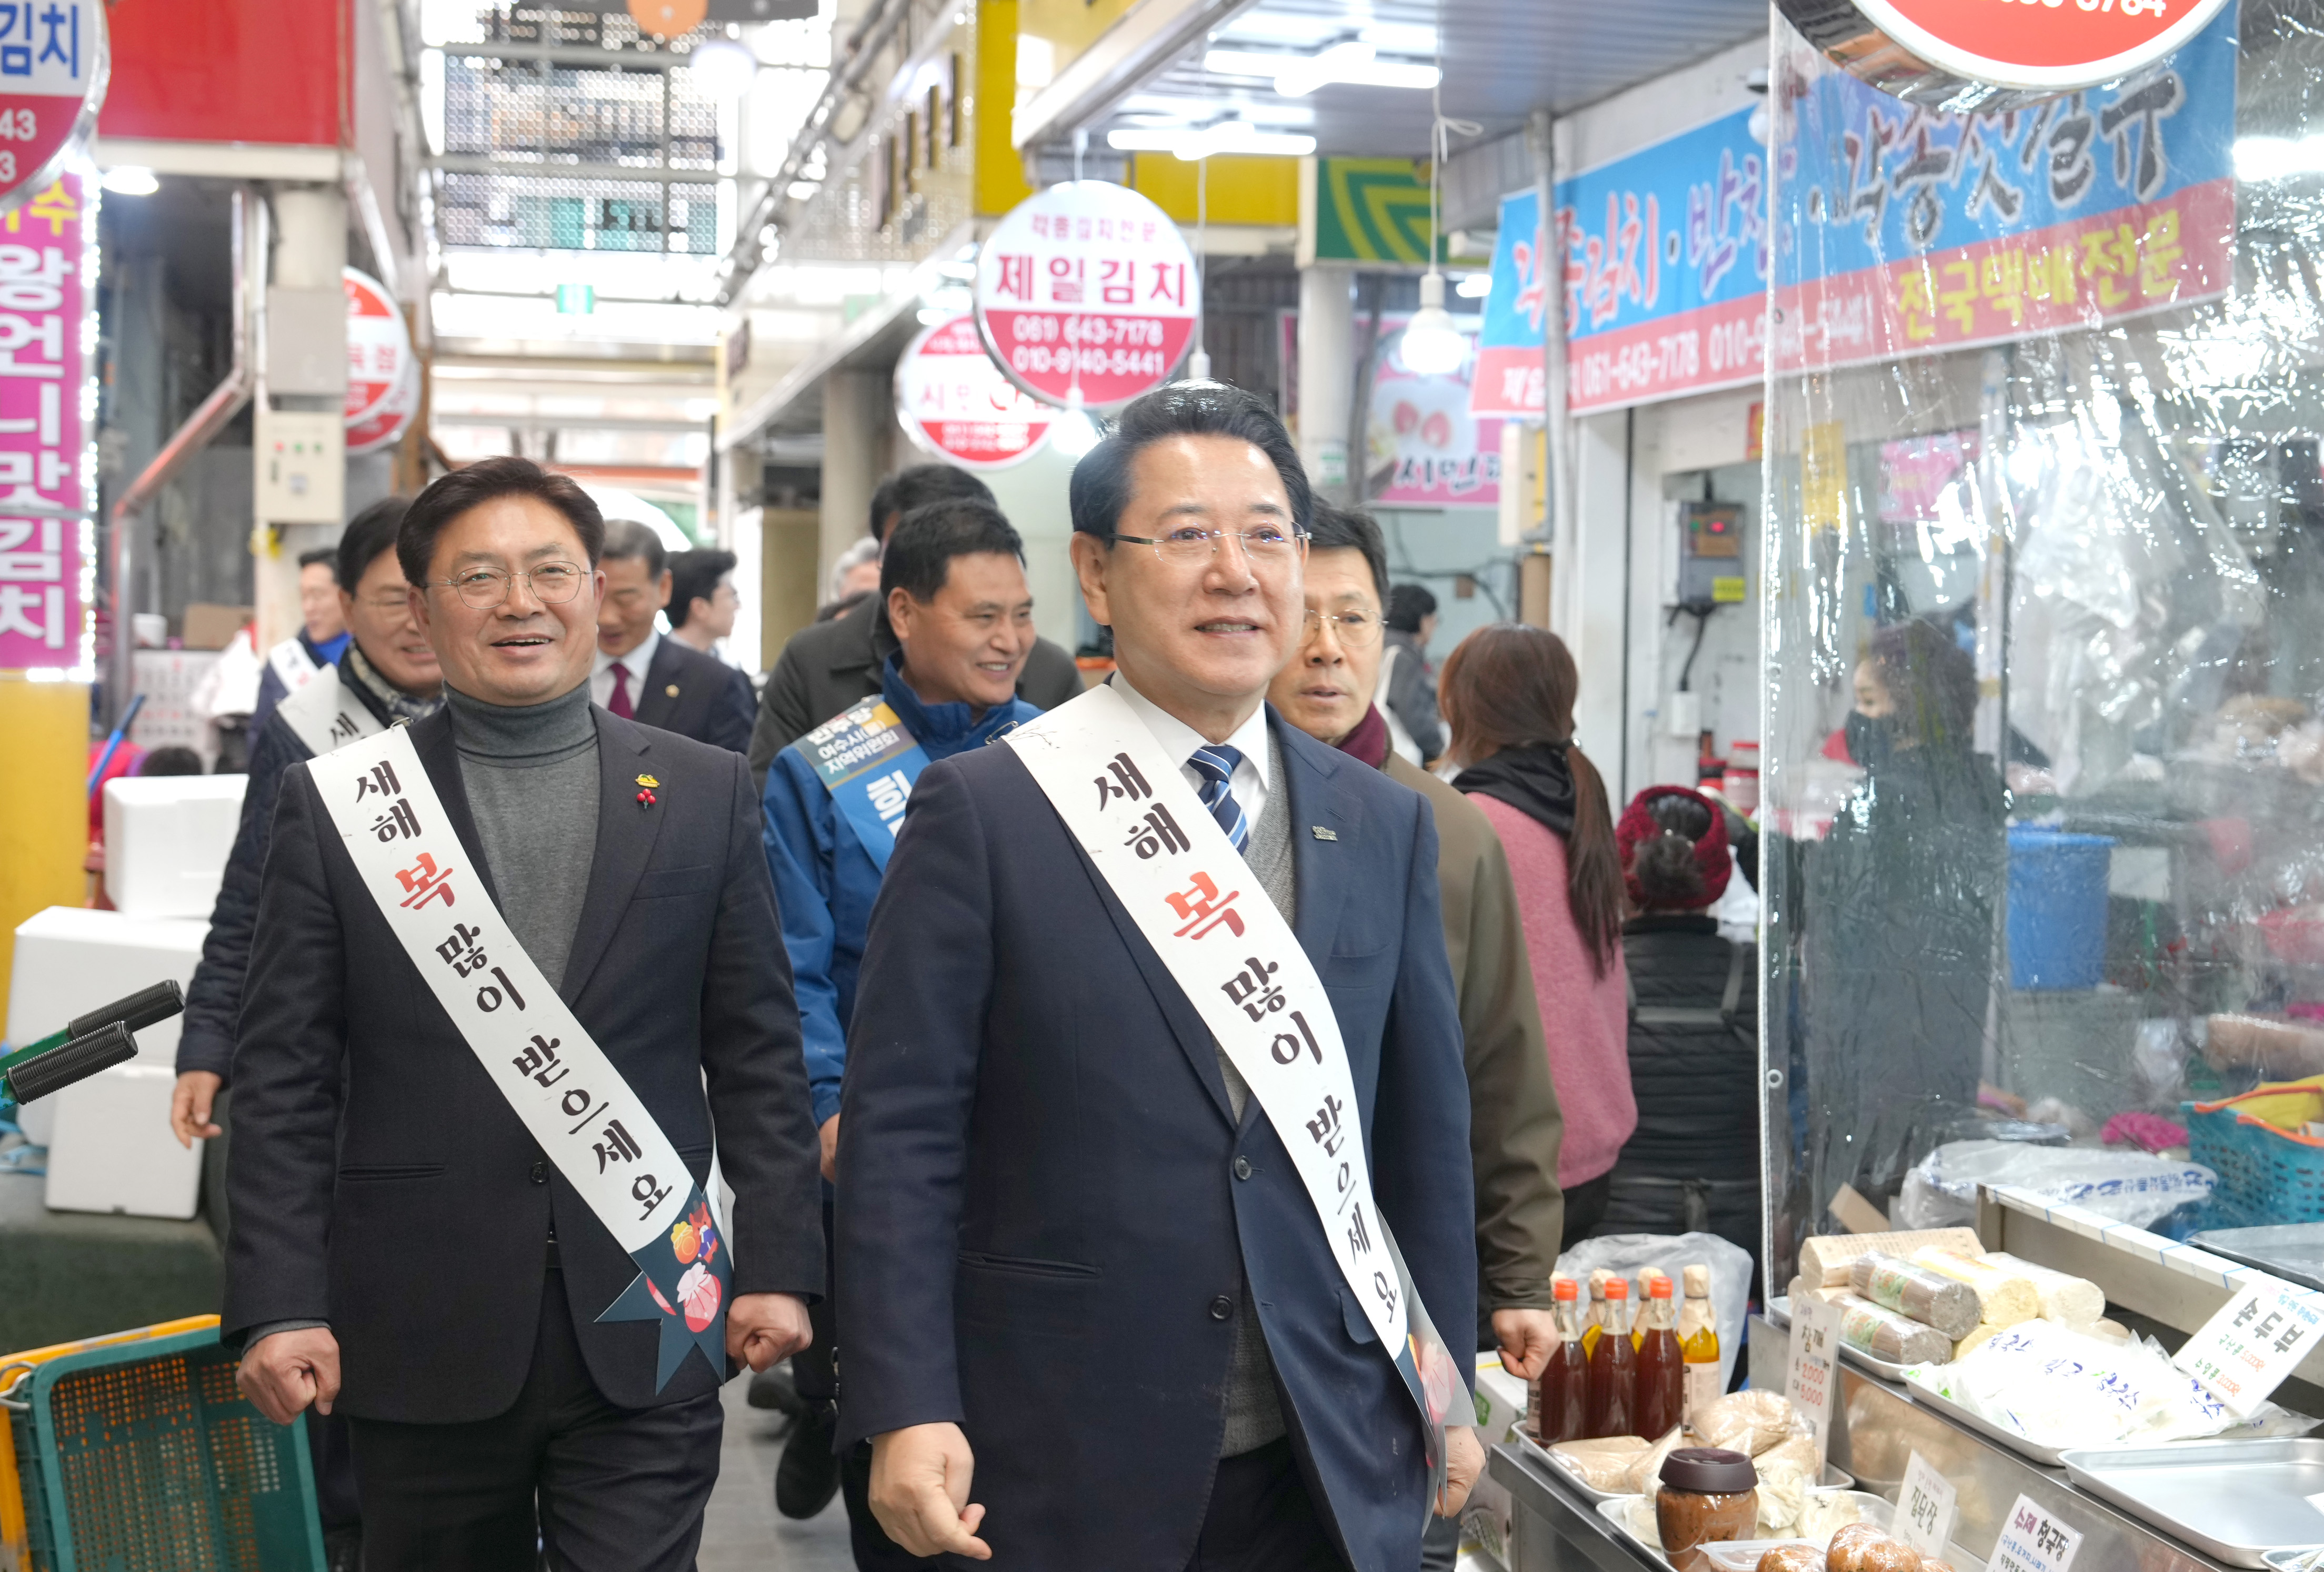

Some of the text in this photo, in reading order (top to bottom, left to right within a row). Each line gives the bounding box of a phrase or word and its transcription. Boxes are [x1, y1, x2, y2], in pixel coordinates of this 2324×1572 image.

[0, 180, 78, 236] 수
[996, 254, 1185, 307] 제일김치
[1064, 315, 1165, 347] 643-7178
[1011, 345, 1165, 377] 010-9140-5441
[823, 729, 900, 775] 지역위원회
[356, 760, 673, 1223] 새해 복 많이 받으세요
[1093, 752, 1400, 1326] 새해 복 많이 받으세요
[2219, 1334, 2244, 1355] 국산콩
[2232, 1297, 2305, 1353] 손두부
[2195, 1358, 2220, 1380] 수입콩
[2014, 1506, 2069, 1563] 수제 청국장
